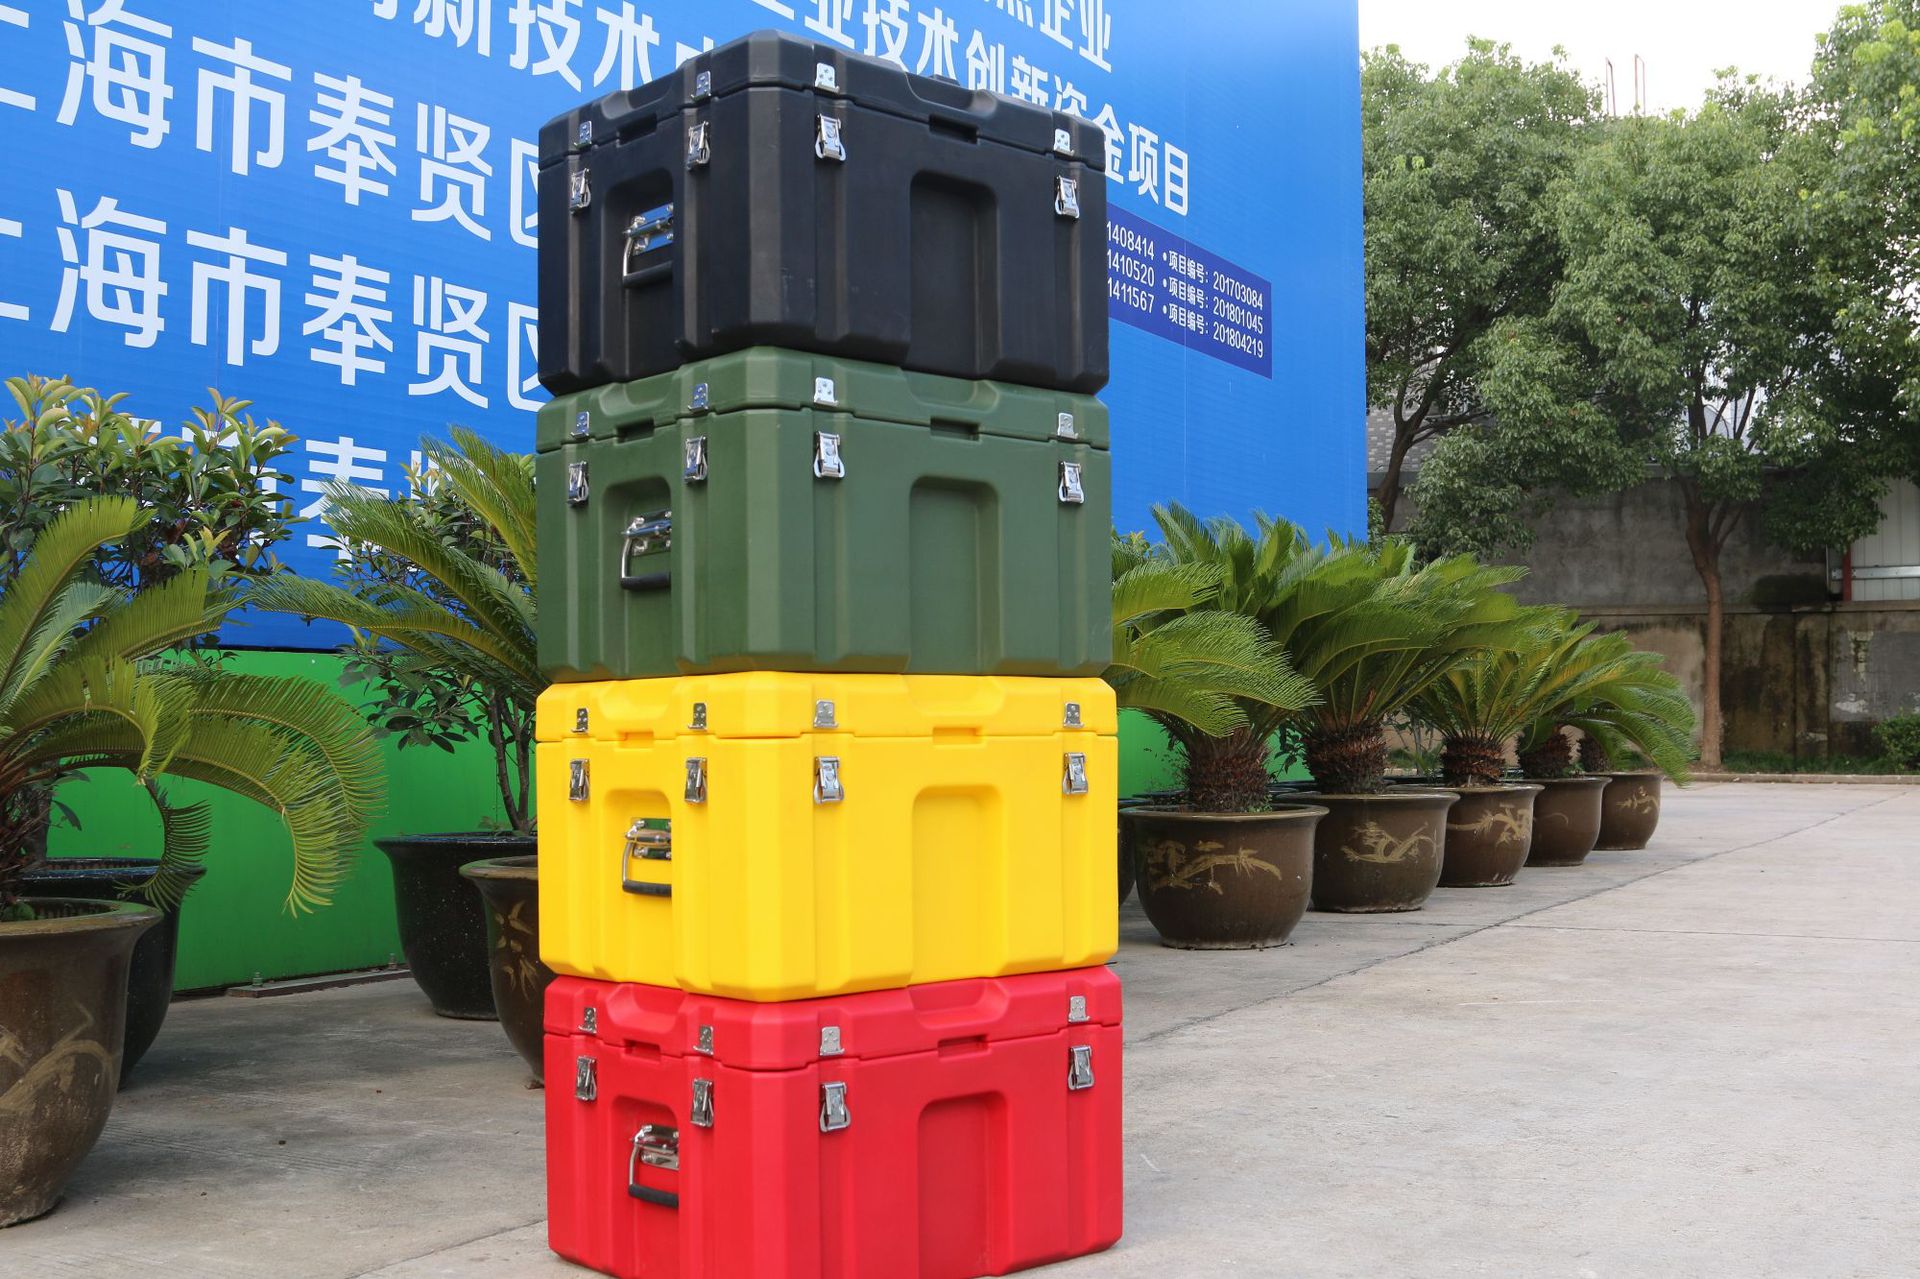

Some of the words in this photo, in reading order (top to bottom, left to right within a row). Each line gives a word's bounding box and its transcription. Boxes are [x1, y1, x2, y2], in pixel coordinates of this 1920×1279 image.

[0, 0, 539, 250] 海市奉贤
[1107, 220, 1155, 260] 1408414
[1107, 248, 1155, 287] 1410520
[0, 188, 547, 413] 海市奉贤
[1107, 276, 1155, 314] 1411567
